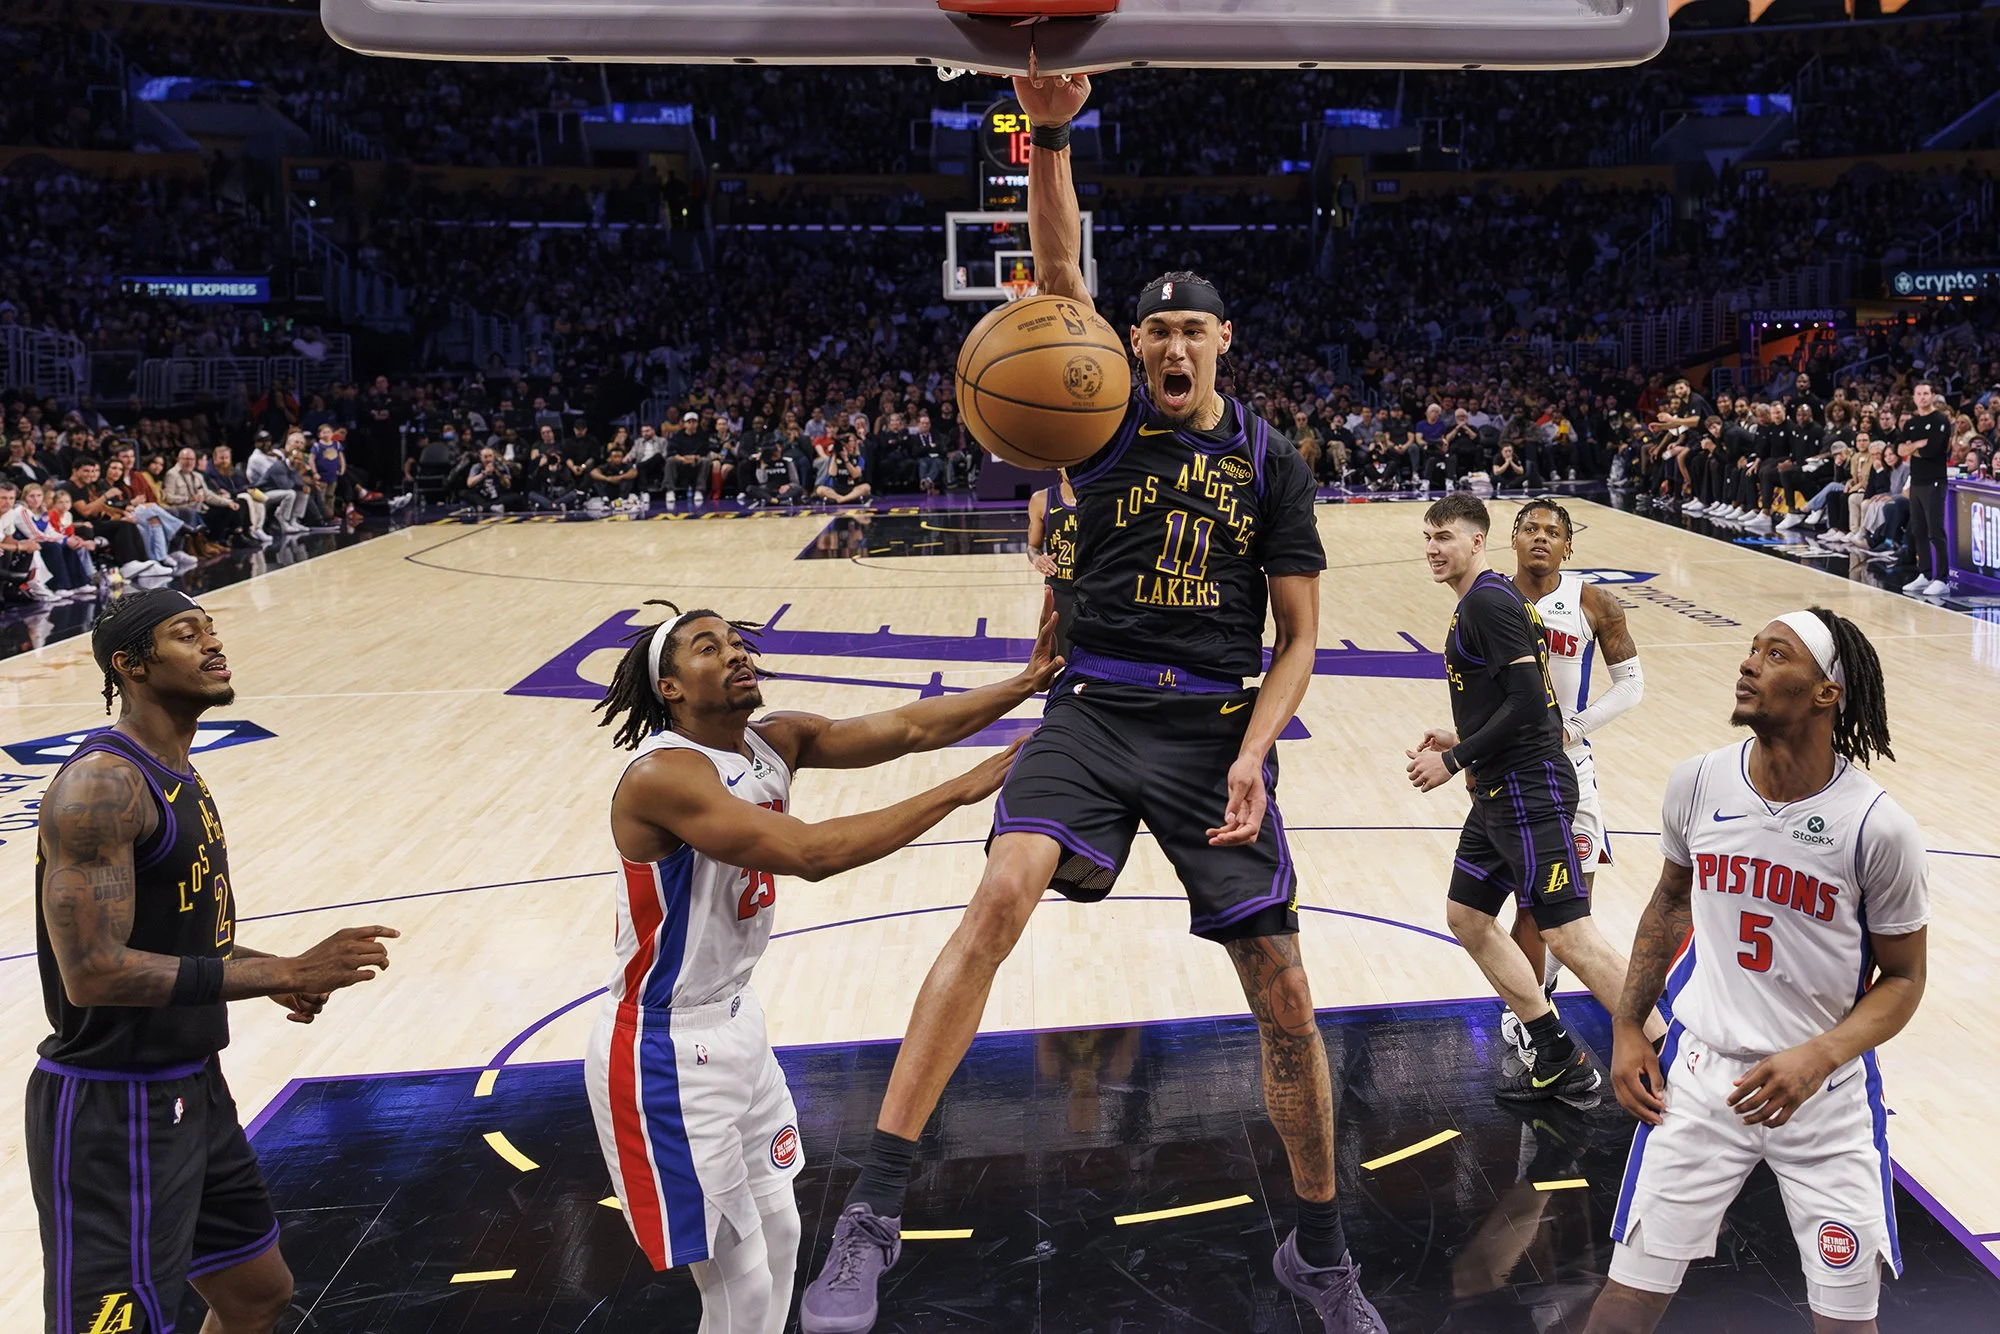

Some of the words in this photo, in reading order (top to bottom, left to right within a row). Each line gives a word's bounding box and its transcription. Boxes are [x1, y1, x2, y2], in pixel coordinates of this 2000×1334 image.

[191, 283, 257, 296] EXPRESS
[1770, 308, 1834, 321] CHAMPIONS
[1221, 460, 1251, 479] bibigo
[1115, 476, 1159, 527] LOS
[1174, 453, 1255, 555] ANGELES
[1155, 510, 1216, 581] 11
[1135, 575, 1220, 606] LAKERS
[1158, 668, 1176, 686] LAL
[1793, 830, 1834, 846] StockX
[1696, 853, 1839, 922] PISTONS
[214, 873, 231, 947] 2
[1737, 911, 1774, 973] 5
[1823, 1235, 1849, 1246] DETROIT
[1823, 1243, 1851, 1254] PISTONS
